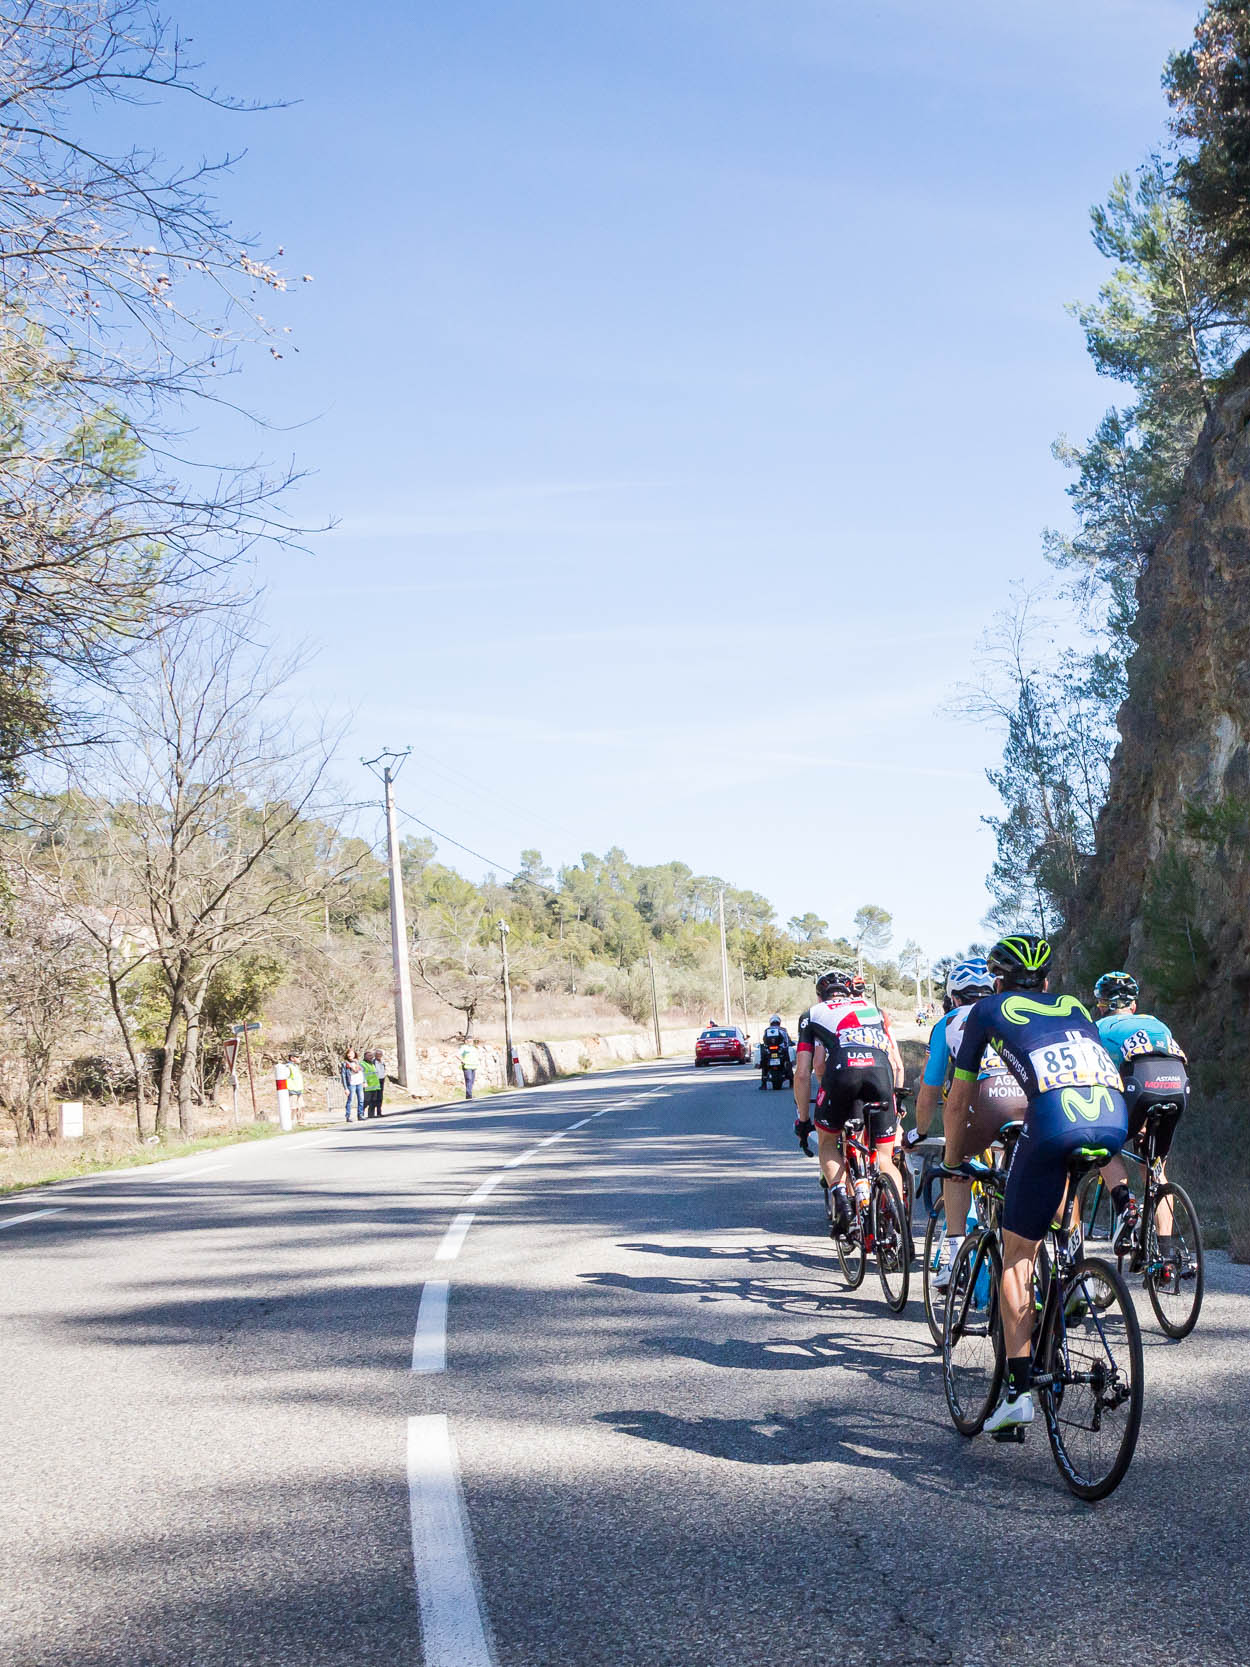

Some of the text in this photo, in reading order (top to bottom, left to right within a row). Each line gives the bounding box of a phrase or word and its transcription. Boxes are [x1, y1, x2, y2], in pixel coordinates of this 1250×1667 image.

[1003, 1048, 1029, 1084] movistar
[1043, 1046, 1077, 1073] 85
[1092, 1045, 1118, 1075] 85
[1043, 1070, 1088, 1089] LCL
[1144, 1080, 1182, 1089] MOTORS
[988, 1086, 1025, 1098] MOND
